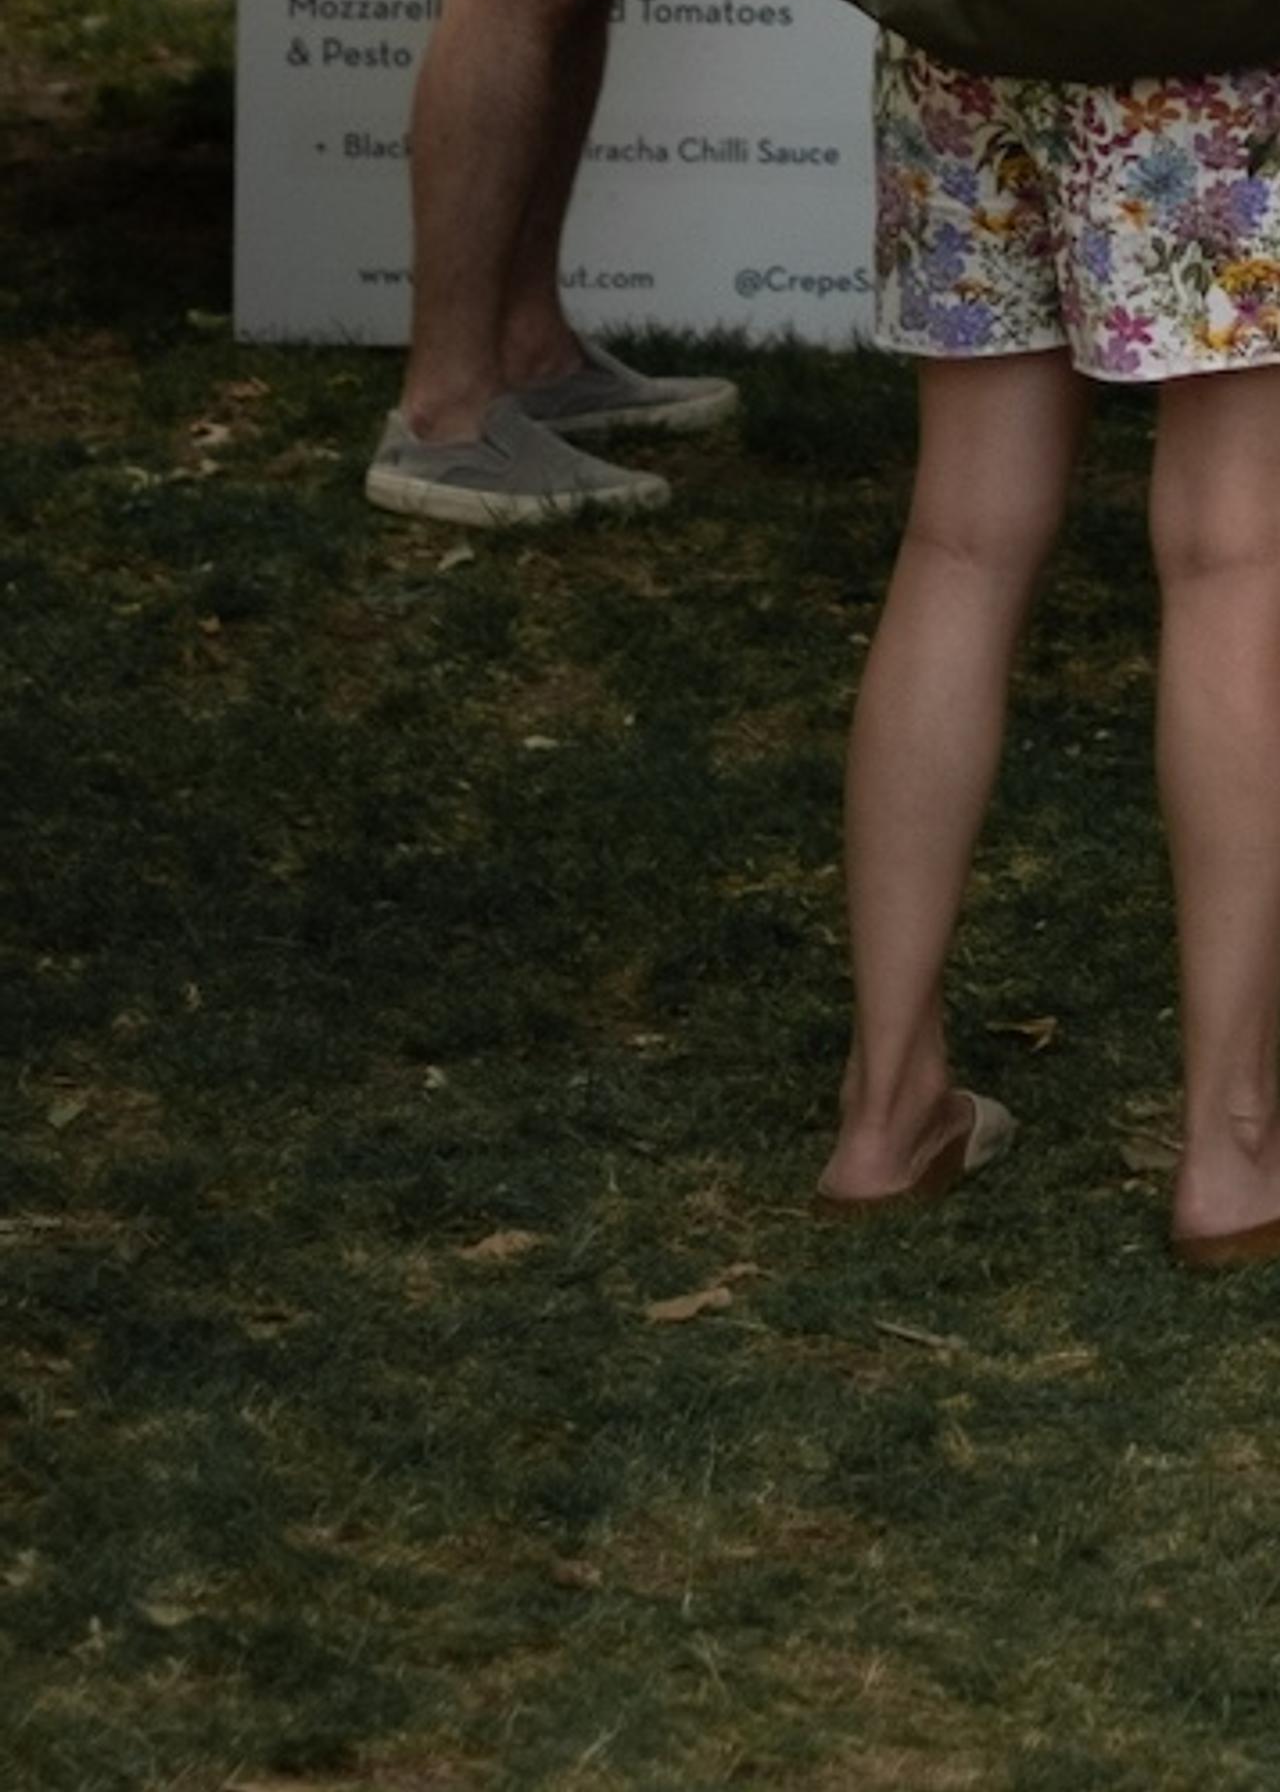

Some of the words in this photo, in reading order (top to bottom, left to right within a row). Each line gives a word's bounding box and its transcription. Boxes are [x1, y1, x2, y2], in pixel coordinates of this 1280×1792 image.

[286, 36, 309, 66] &
[322, 36, 413, 68] Pesto
[677, 137, 749, 163] Chilli
[757, 138, 841, 165] Sauce
